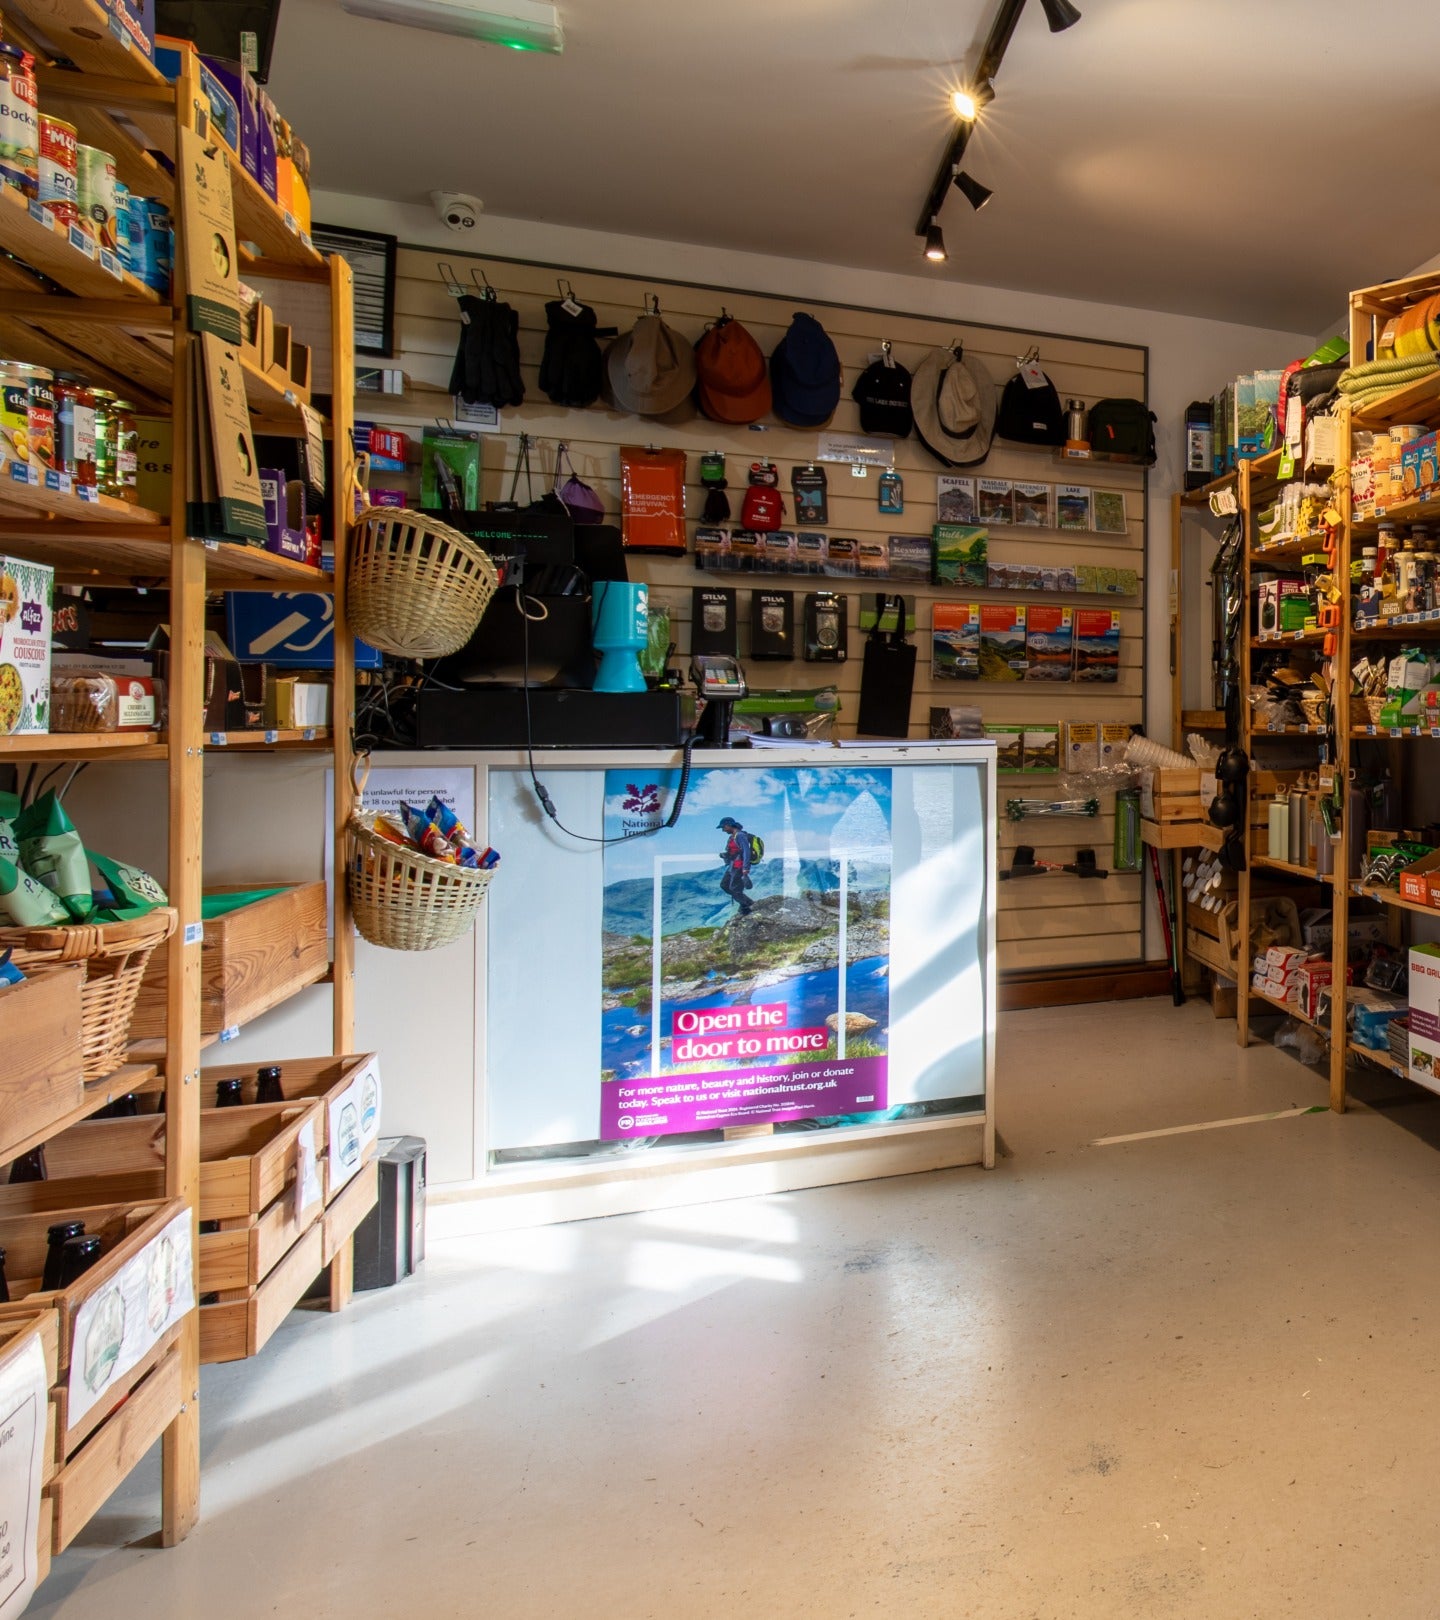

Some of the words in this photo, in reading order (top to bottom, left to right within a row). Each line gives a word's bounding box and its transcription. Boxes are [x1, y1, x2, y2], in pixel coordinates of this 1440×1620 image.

[942, 478, 970, 486] SCAFELL
[630, 493, 677, 502] EMERGENCY
[630, 500, 668, 508] SURVIVAL
[474, 530, 512, 540] WELCOME
[893, 546, 929, 555] Keswick
[702, 593, 728, 601] SILVA
[761, 595, 785, 603] SILVA
[815, 600, 839, 608] SILVA
[13, 647, 46, 662] COUSCOUS
[371, 788, 403, 797] unlawful
[405, 788, 416, 796] for
[417, 790, 447, 799] persons
[391, 798, 426, 808] puchase
[622, 819, 665, 829] National
[621, 829, 647, 837] Trust
[1405, 882, 1420, 896] BITES
[1411, 963, 1426, 974] BBQ
[677, 1012, 741, 1036] Open
[747, 1007, 784, 1028] the
[677, 1038, 732, 1060] door
[738, 1037, 761, 1054] to
[766, 1032, 824, 1052] more
[618, 1088, 635, 1097] For
[637, 1087, 664, 1096] more
[665, 1082, 700, 1094] nature,
[702, 1078, 735, 1092] beauty
[736, 1076, 755, 1087] and
[756, 1073, 791, 1086] history,
[791, 1071, 809, 1083] join
[811, 1070, 821, 1079] or
[823, 1067, 855, 1078] donate
[618, 1098, 649, 1110] today.
[651, 1095, 682, 1107] Speak
[683, 1094, 694, 1103] to
[696, 1093, 708, 1102] us
[709, 1092, 720, 1101] or
[722, 1088, 741, 1099] visit
[742, 1079, 838, 1097] nationaltrust.org.uk
